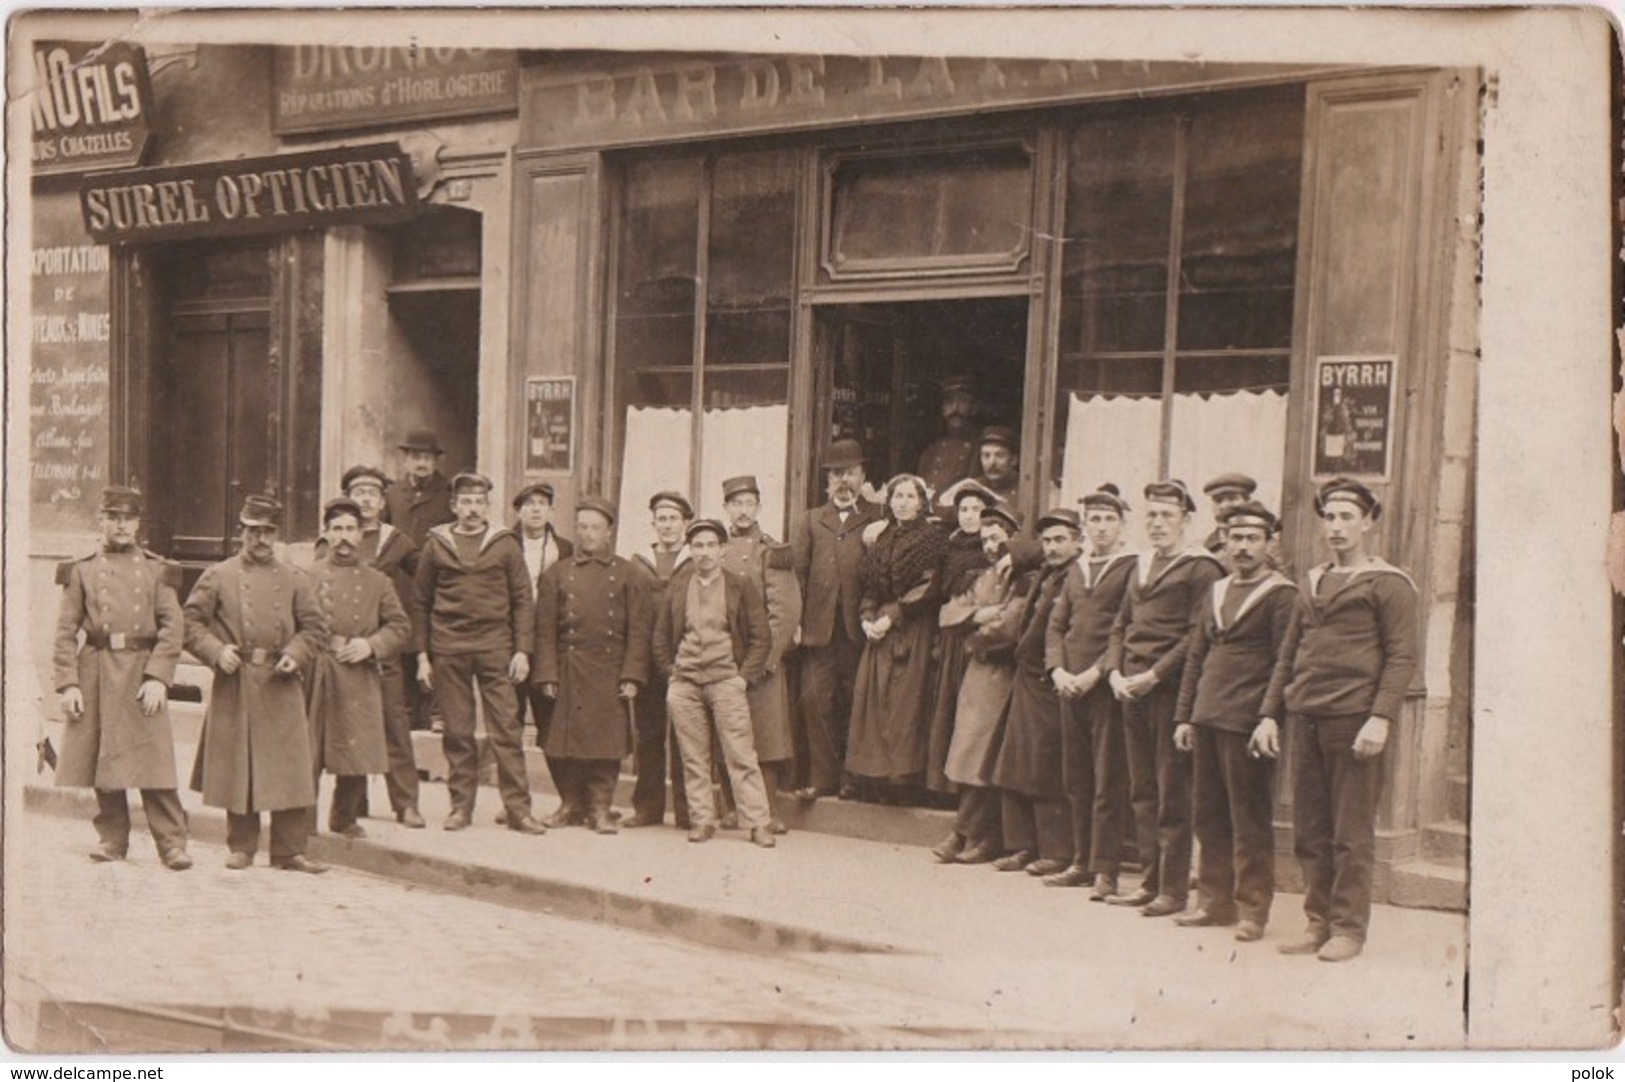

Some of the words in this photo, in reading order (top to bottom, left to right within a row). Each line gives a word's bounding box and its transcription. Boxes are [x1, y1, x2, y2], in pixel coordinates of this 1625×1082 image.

[573, 65, 717, 124] BAR
[740, 54, 826, 108] DE
[86, 179, 210, 231] SUREL
[215, 157, 406, 222] OPTICIEN
[1321, 363, 1388, 387] BYRRH
